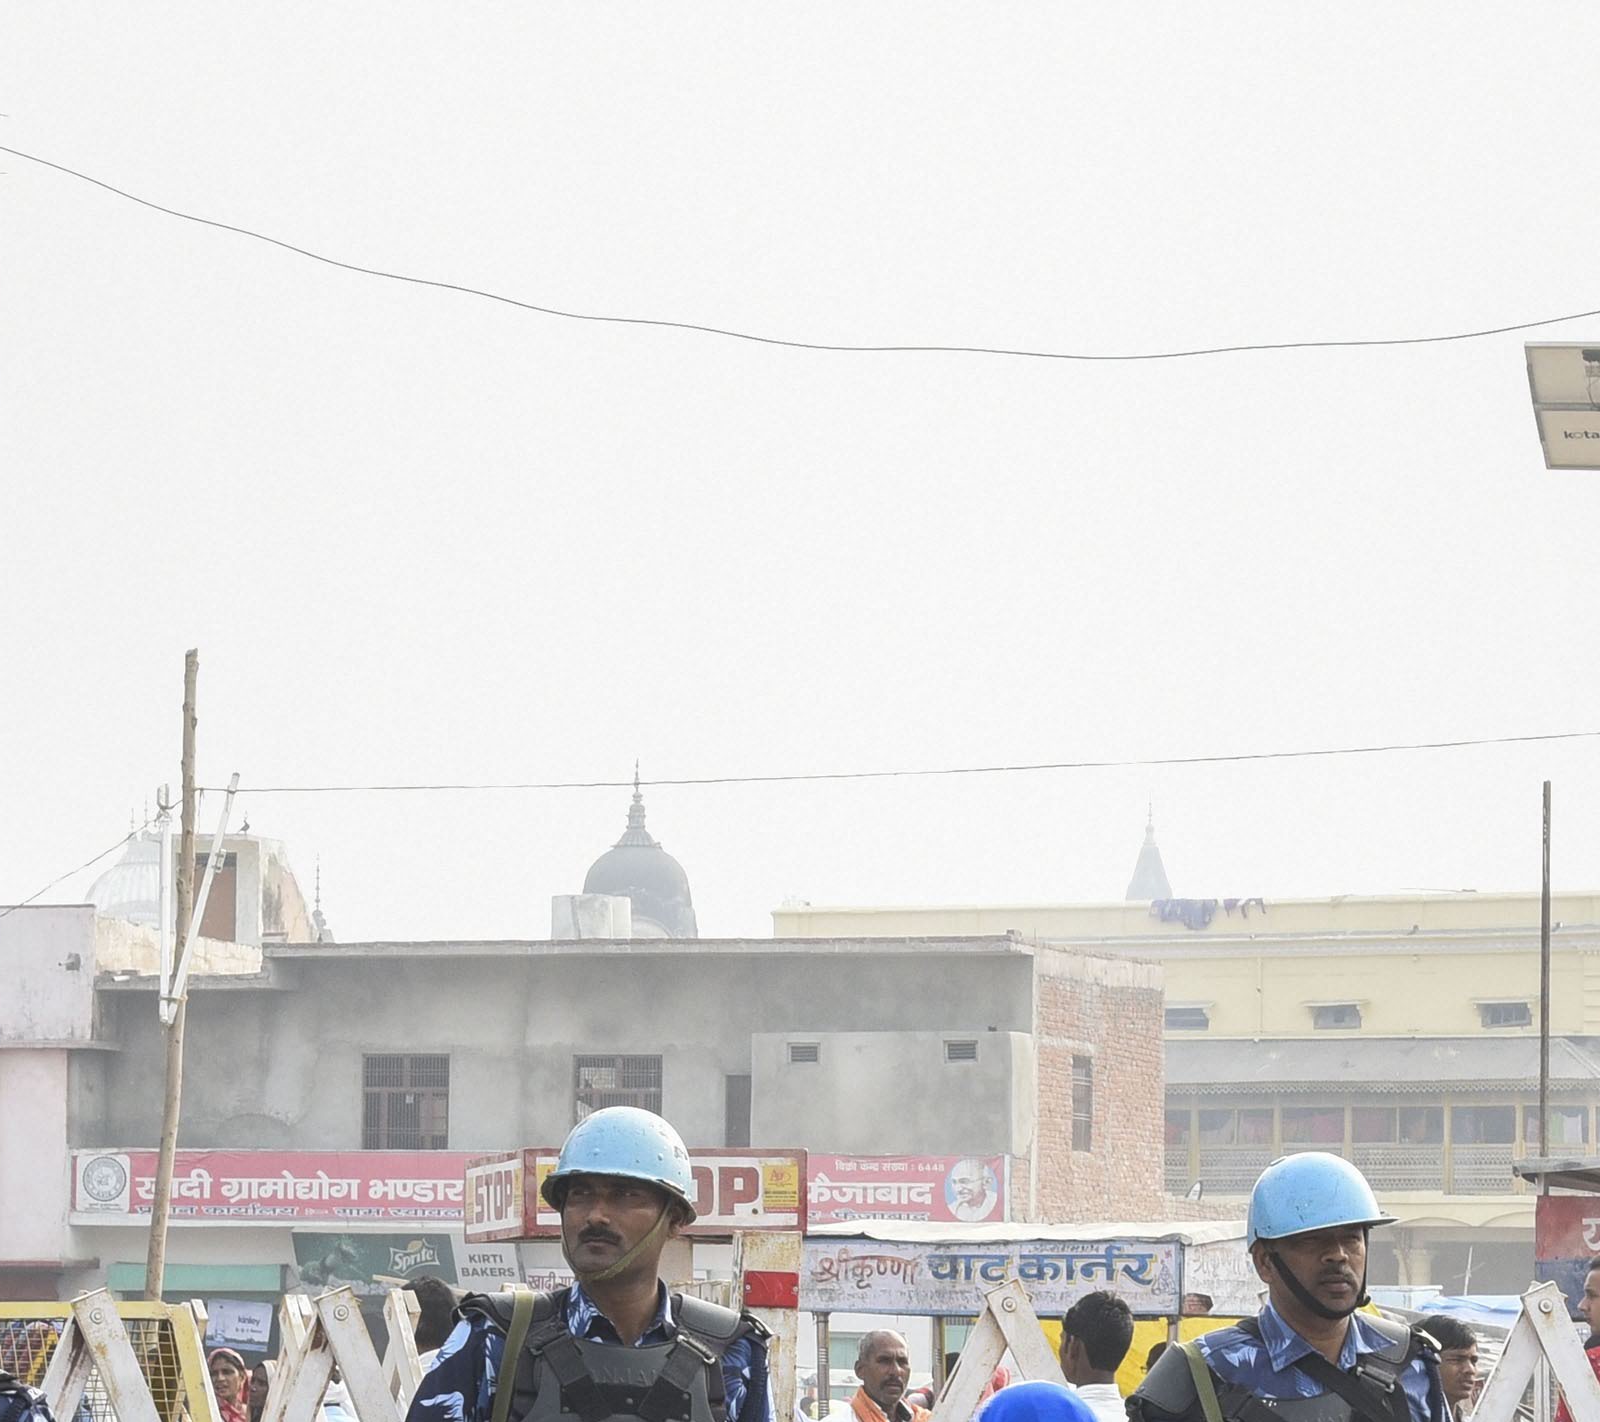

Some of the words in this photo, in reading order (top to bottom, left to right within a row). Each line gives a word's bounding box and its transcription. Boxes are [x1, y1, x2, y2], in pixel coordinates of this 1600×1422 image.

[221, 1169, 360, 1203] ग्रामोद्योग
[368, 1177, 464, 1203] भण्डार
[808, 1172, 935, 1205] फैजाबाद
[475, 1169, 514, 1225] STOP
[393, 1247, 434, 1271] Sprite
[461, 1266, 515, 1278] BAKERS
[468, 1253, 504, 1264] KIRTI
[927, 1252, 1016, 1283] चाट
[1017, 1245, 1158, 1287] कार्नर
